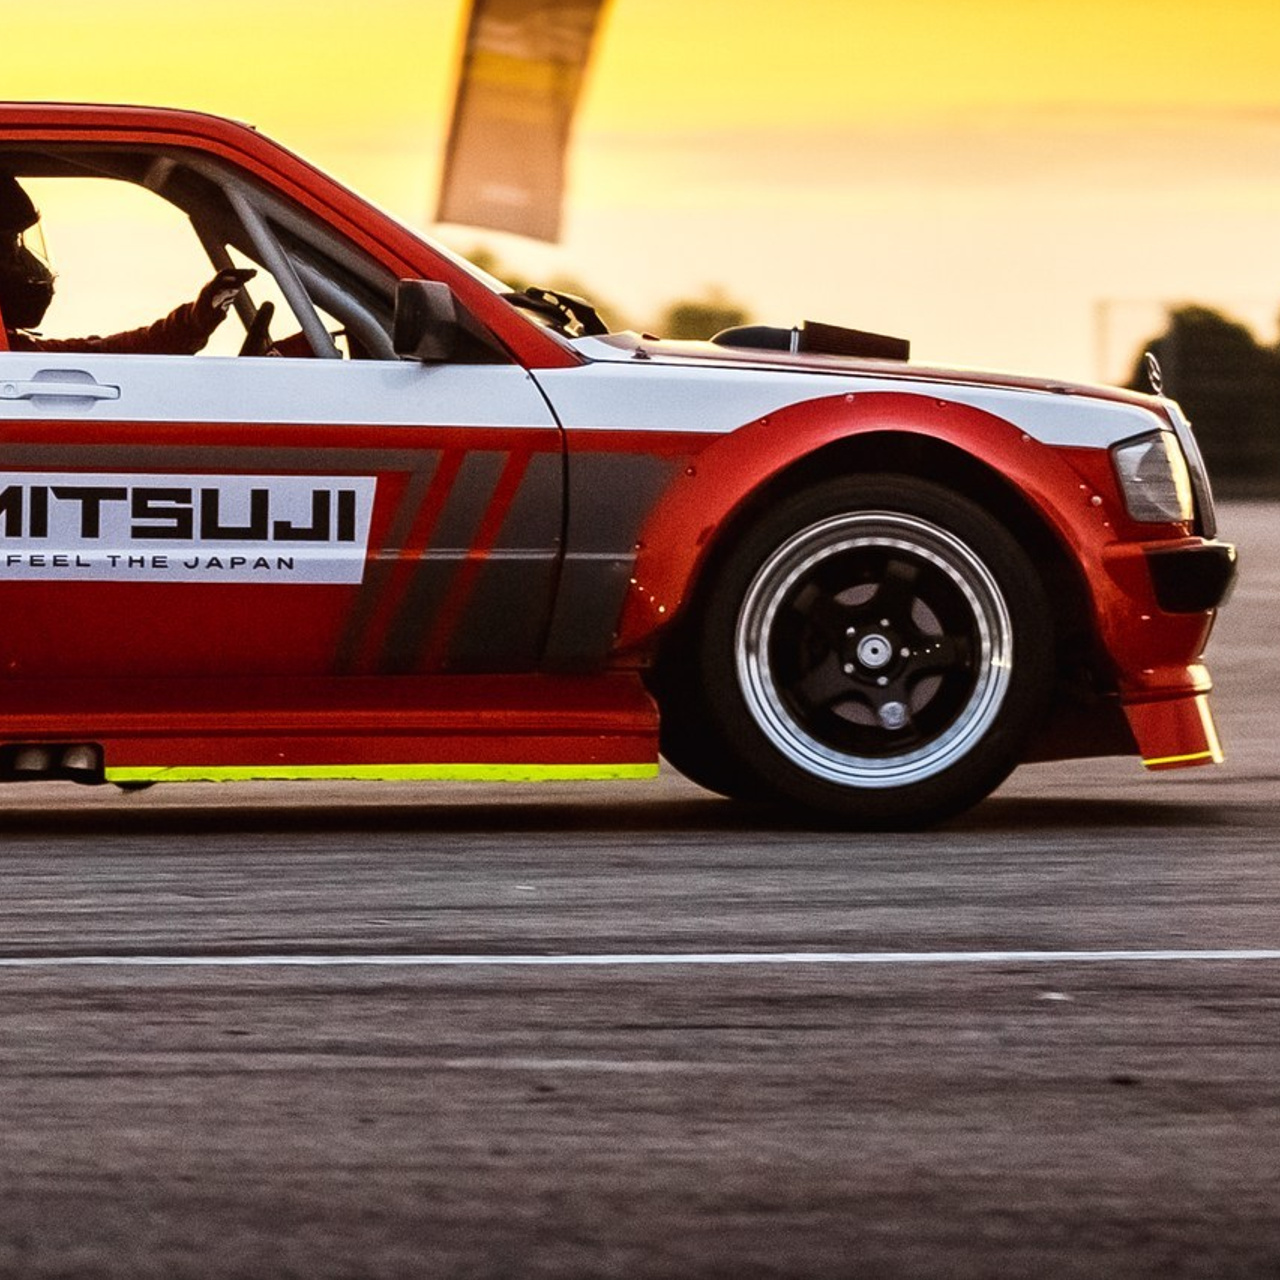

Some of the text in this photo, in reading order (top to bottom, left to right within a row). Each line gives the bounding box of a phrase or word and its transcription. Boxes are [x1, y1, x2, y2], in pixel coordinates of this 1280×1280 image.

[5, 554, 295, 570] FEEL THE JAPAN
